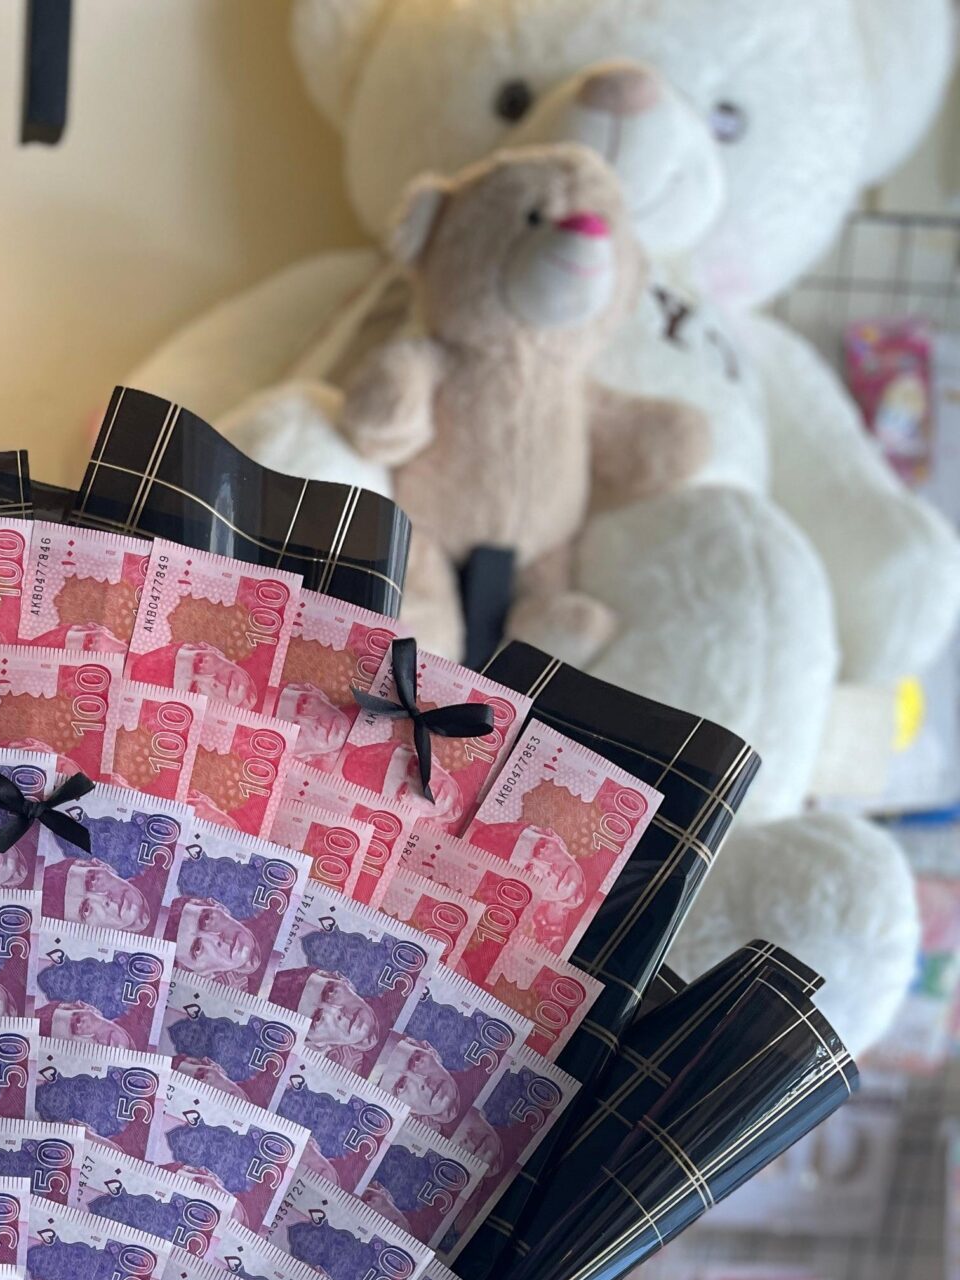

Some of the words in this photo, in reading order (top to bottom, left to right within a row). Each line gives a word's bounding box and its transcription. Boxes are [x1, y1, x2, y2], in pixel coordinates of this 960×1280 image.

[245, 579, 290, 647] 100
[71, 664, 112, 736] 100
[148, 702, 193, 773] 100
[238, 728, 286, 798] 100
[138, 814, 181, 870] 50
[592, 787, 648, 853] 100
[253, 858, 297, 915] 50
[476, 878, 532, 945] 100
[122, 952, 164, 1008] 50
[378, 941, 428, 997] 50
[530, 976, 586, 1041] 100
[249, 1021, 297, 1077] 50
[464, 1018, 515, 1074] 50
[117, 1067, 159, 1124] 50
[510, 1076, 562, 1131] 50
[246, 1131, 295, 1190] 50
[343, 1104, 392, 1161] 50
[33, 1138, 74, 1195] 50
[417, 1158, 470, 1214] 50
[172, 1199, 220, 1258] 50
